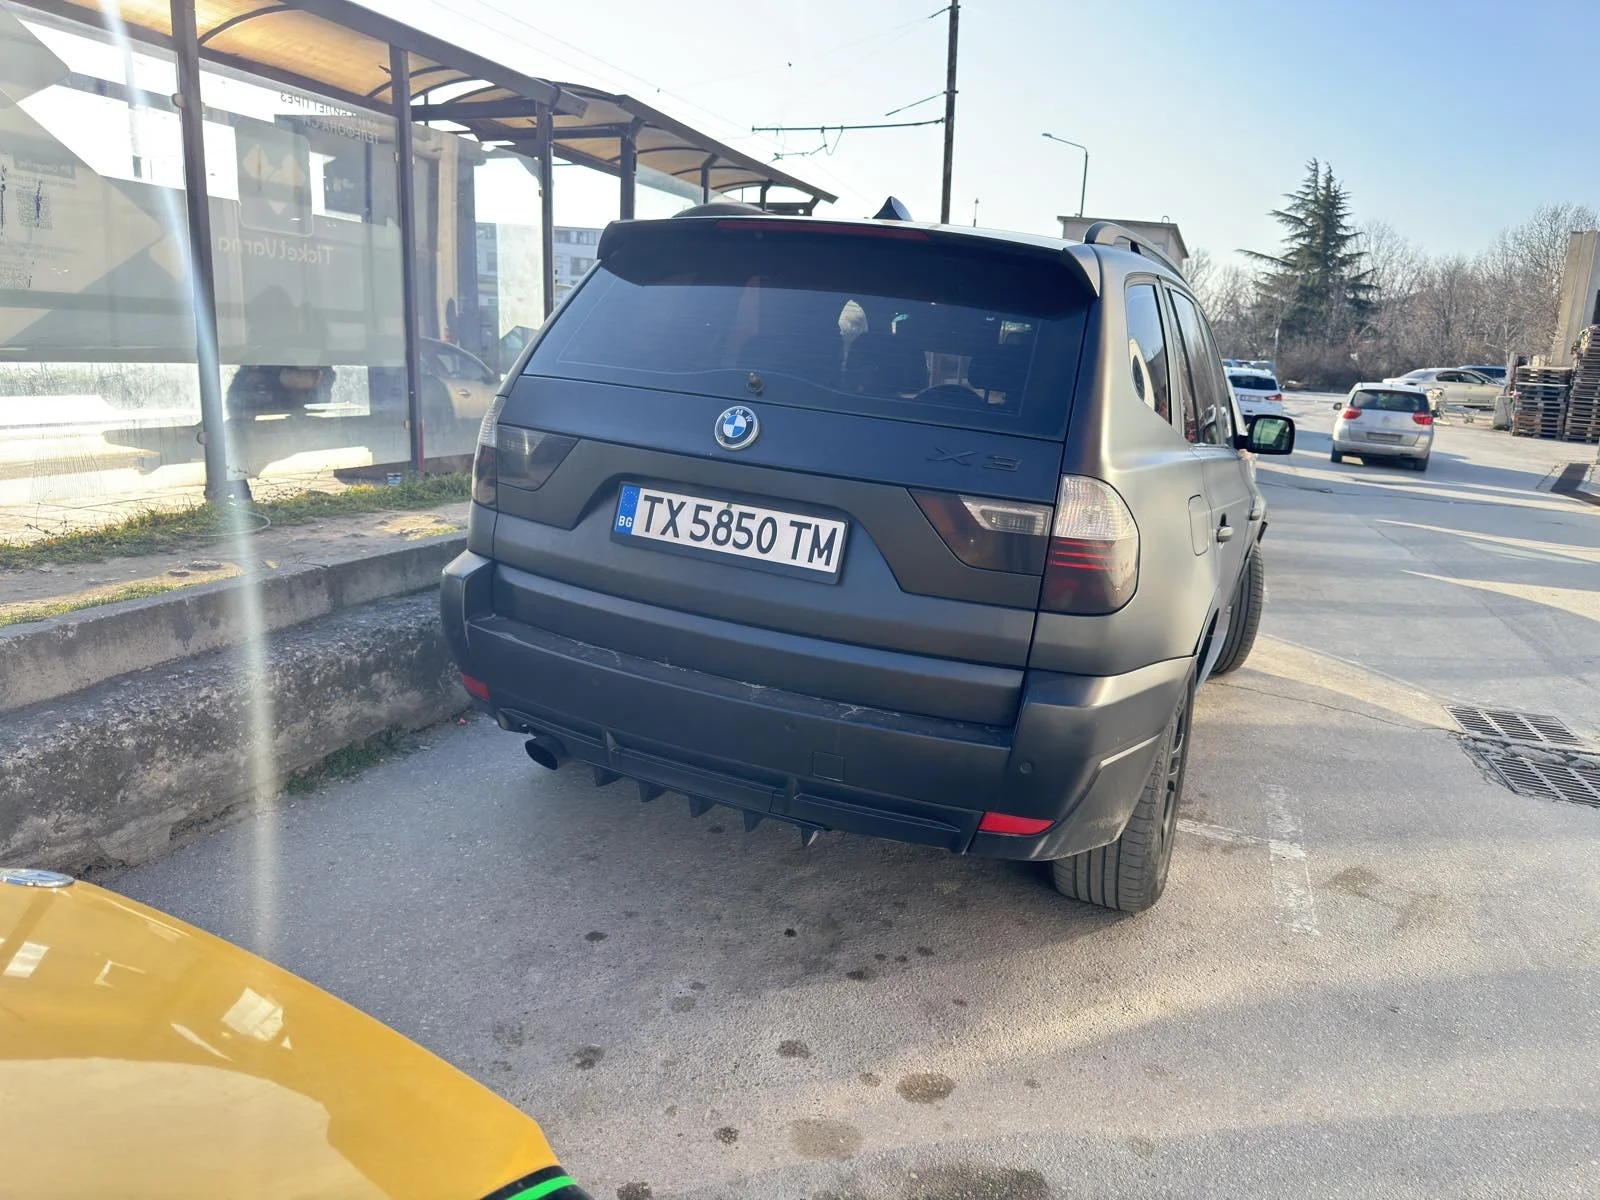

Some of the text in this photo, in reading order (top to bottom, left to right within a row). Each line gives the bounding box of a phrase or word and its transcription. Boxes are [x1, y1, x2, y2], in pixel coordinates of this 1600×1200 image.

[724, 409, 753, 422] BMW
[925, 446, 1021, 472] X3
[618, 515, 632, 527] BG
[644, 495, 838, 566] TX 5850 TM
